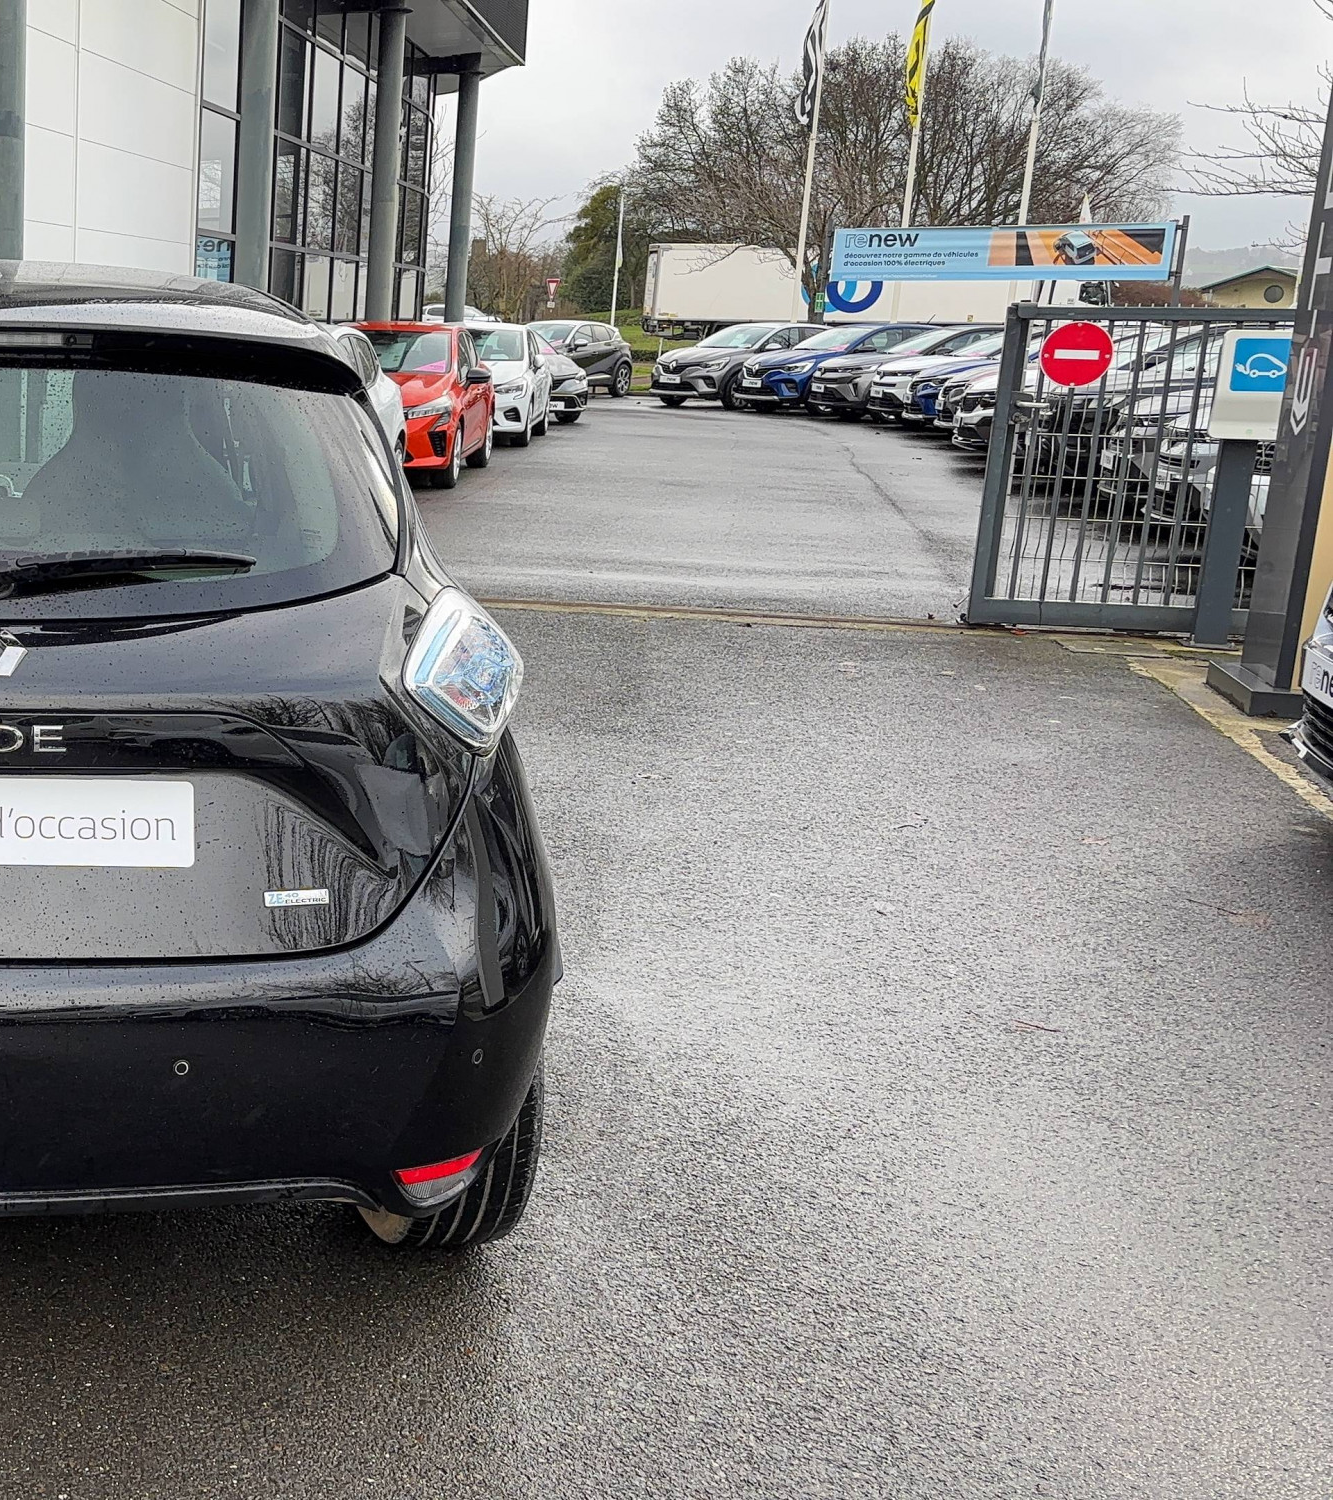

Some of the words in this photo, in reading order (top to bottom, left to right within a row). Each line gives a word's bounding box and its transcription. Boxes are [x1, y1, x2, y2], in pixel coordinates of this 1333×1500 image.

[844, 233, 920, 248] renew
[903, 252, 932, 260] gamme
[904, 259, 946, 267] électriques
